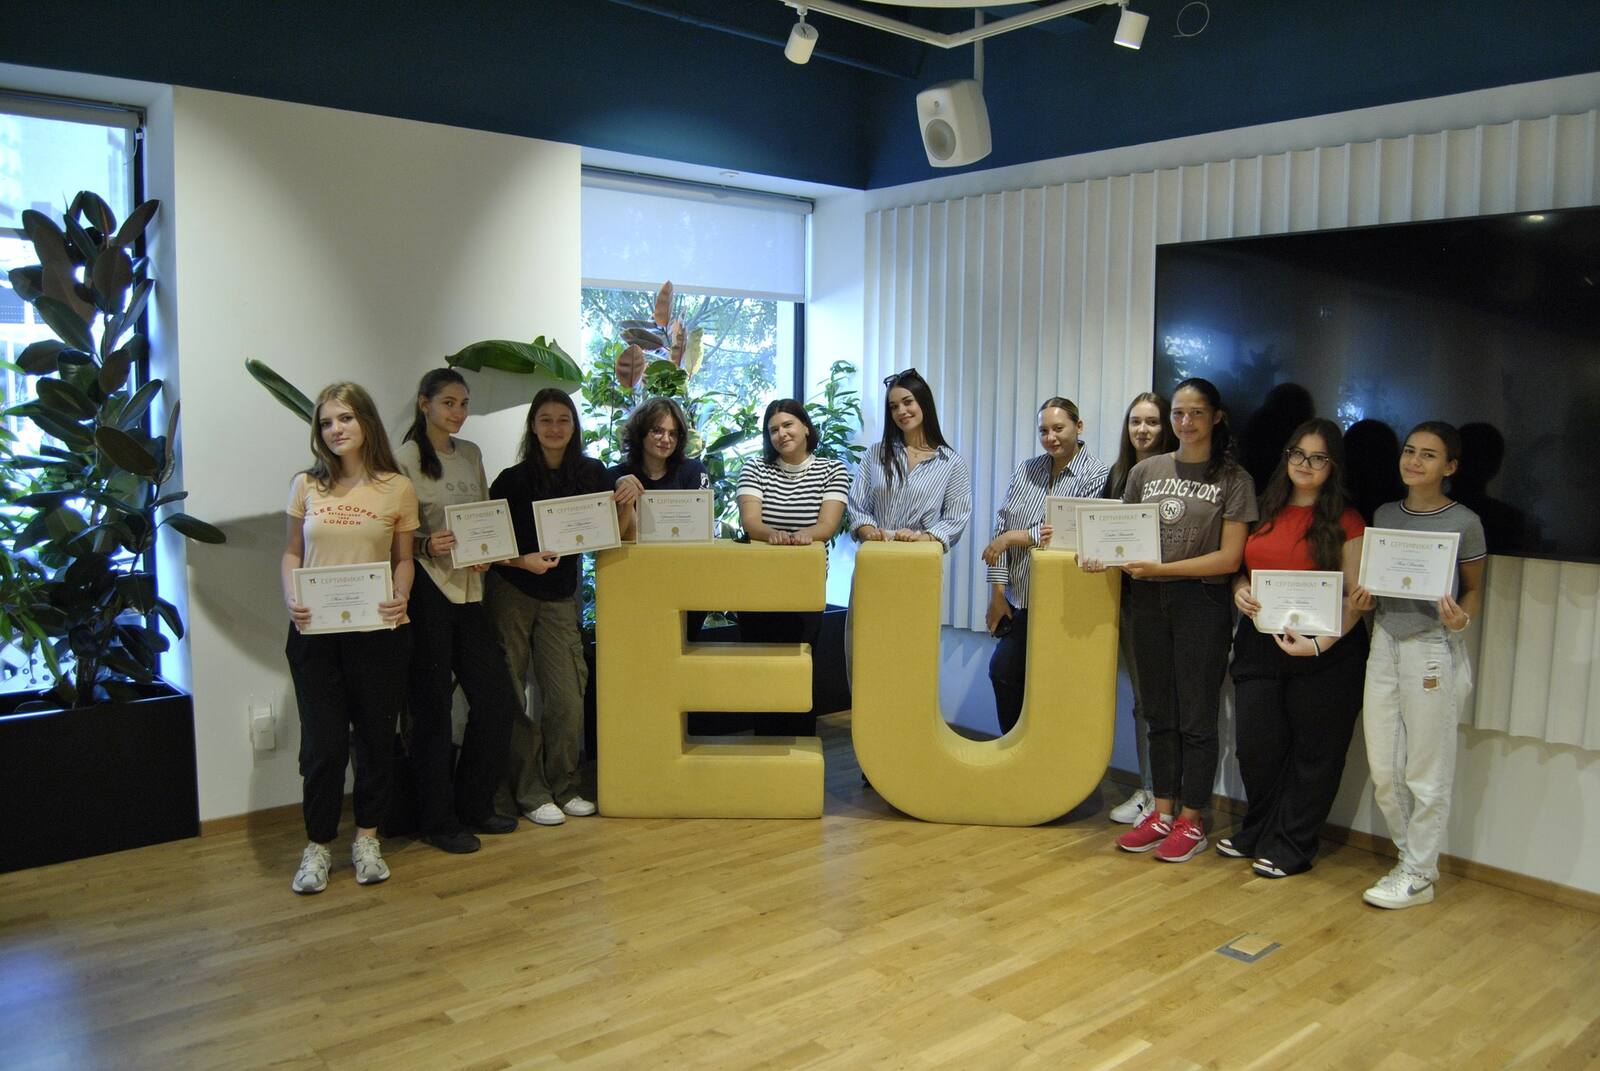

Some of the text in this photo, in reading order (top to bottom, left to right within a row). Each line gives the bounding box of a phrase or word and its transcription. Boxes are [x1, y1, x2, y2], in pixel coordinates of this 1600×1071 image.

[313, 506, 332, 516] LEE
[337, 504, 378, 519] COOPER
[597, 540, 1121, 827] EU
